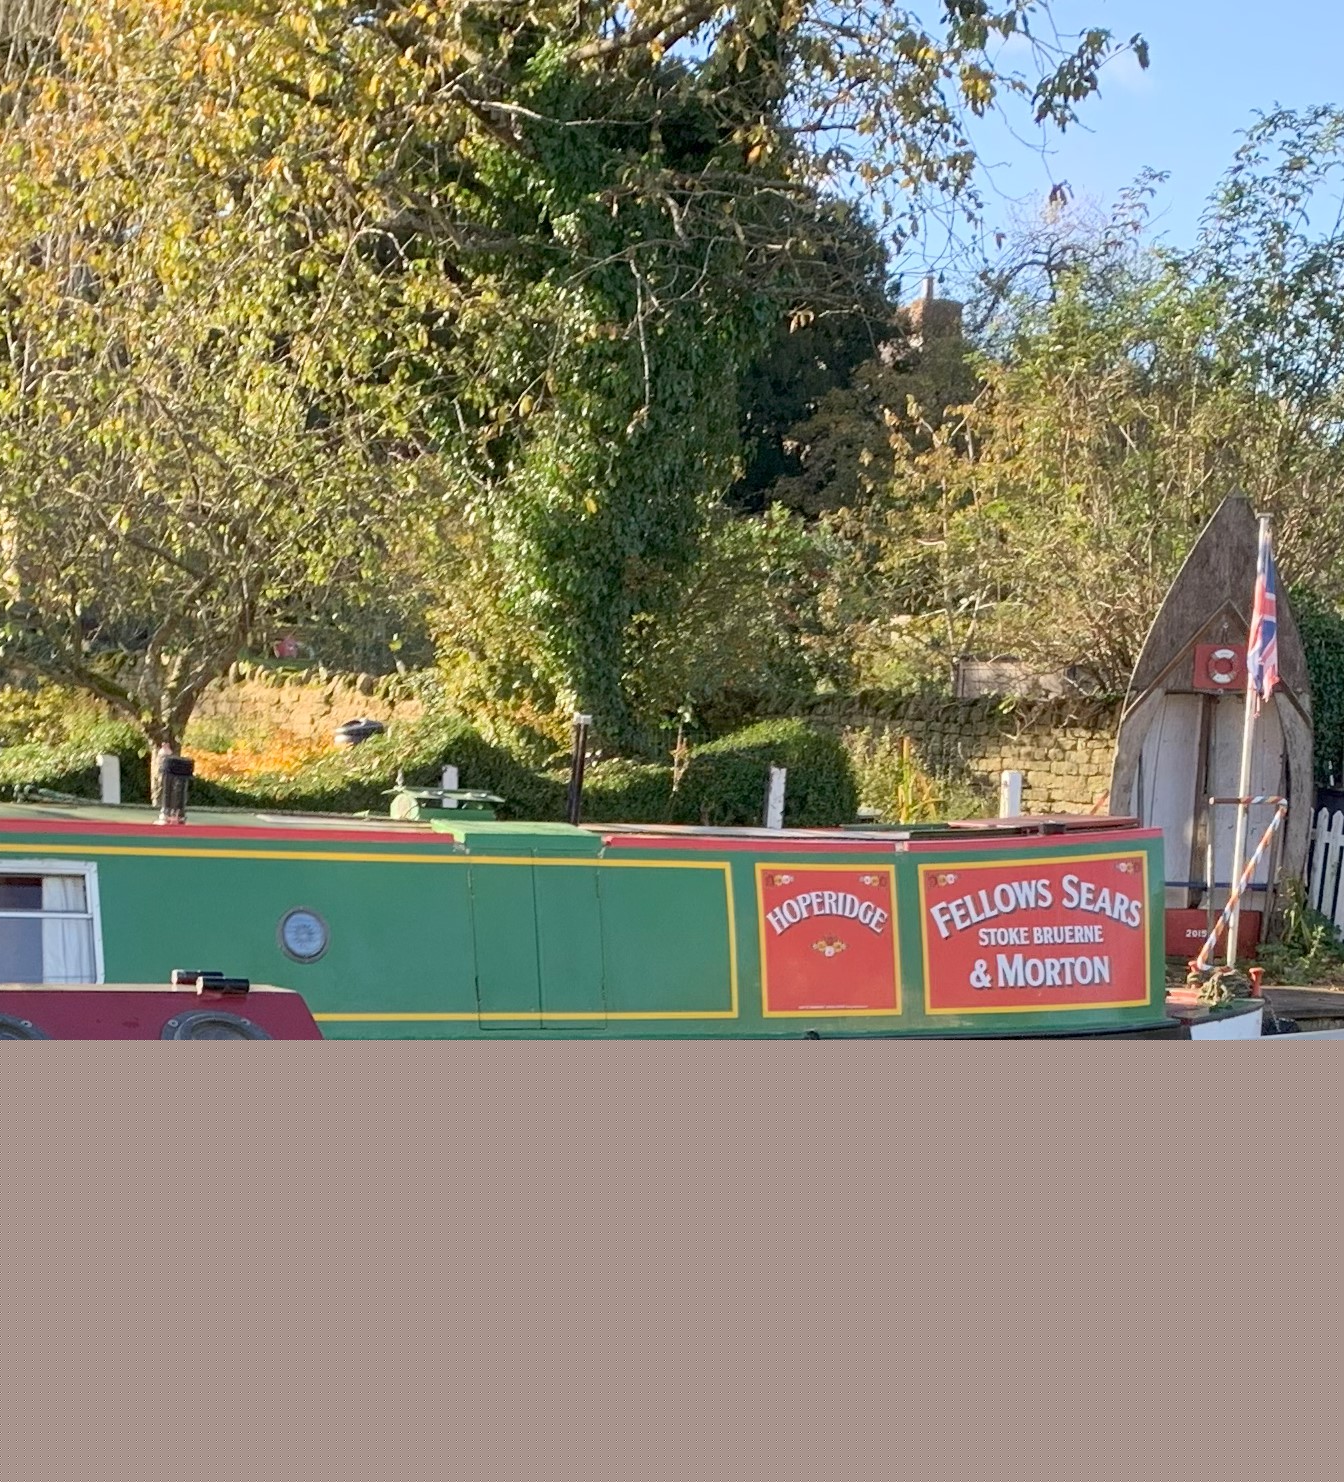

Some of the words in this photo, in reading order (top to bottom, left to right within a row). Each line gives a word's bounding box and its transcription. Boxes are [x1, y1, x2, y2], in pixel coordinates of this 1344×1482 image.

[766, 890, 889, 935] HOPERIDGE
[930, 879, 1053, 939] FELLOWS
[1061, 874, 1142, 928] SEARS
[978, 927, 1030, 946] STOKE
[1033, 924, 1104, 944] BRUERNE
[969, 958, 993, 989] &
[996, 953, 1110, 988] MORTON
